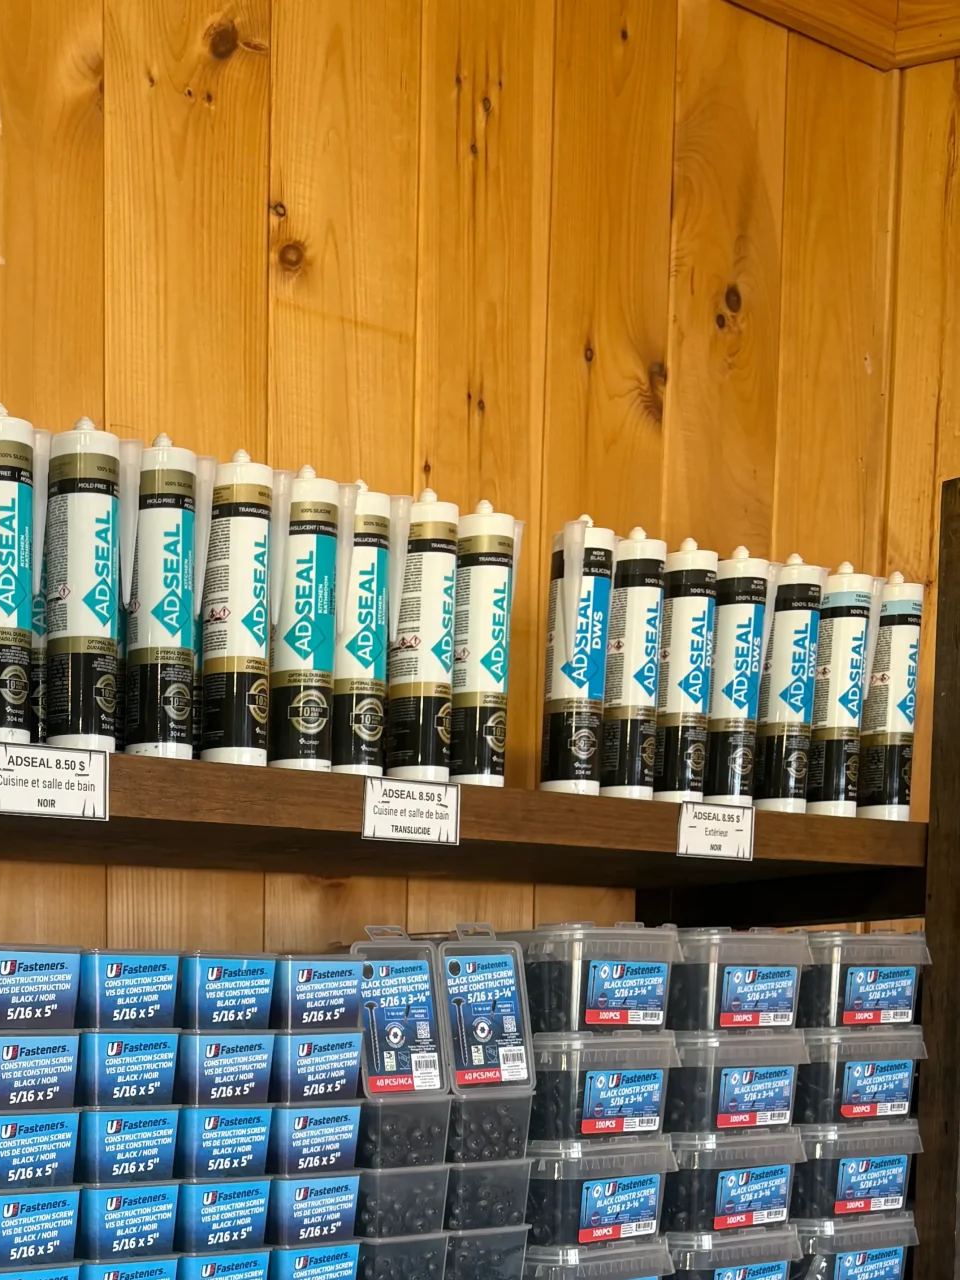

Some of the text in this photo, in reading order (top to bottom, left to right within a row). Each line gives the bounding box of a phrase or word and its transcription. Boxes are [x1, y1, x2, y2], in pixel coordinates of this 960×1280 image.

[294, 550, 313, 651] ADSEAL
[591, 611, 603, 649] DWS
[732, 617, 752, 702] ADSEAL
[8, 756, 85, 771] ADSEAL 8.50 $
[32, 778, 39, 788] et
[42, 778, 62, 789] salle
[65, 780, 75, 790] de
[78, 781, 95, 792] bain
[382, 789, 416, 800] ADSEAL
[419, 792, 434, 802] 8.50
[38, 799, 55, 808] NOIR
[693, 812, 720, 821] ADSEAL
[722, 814, 734, 822] 8.95
[391, 825, 431, 835] TRANSLUCIDE
[705, 828, 728, 837] Extérieur
